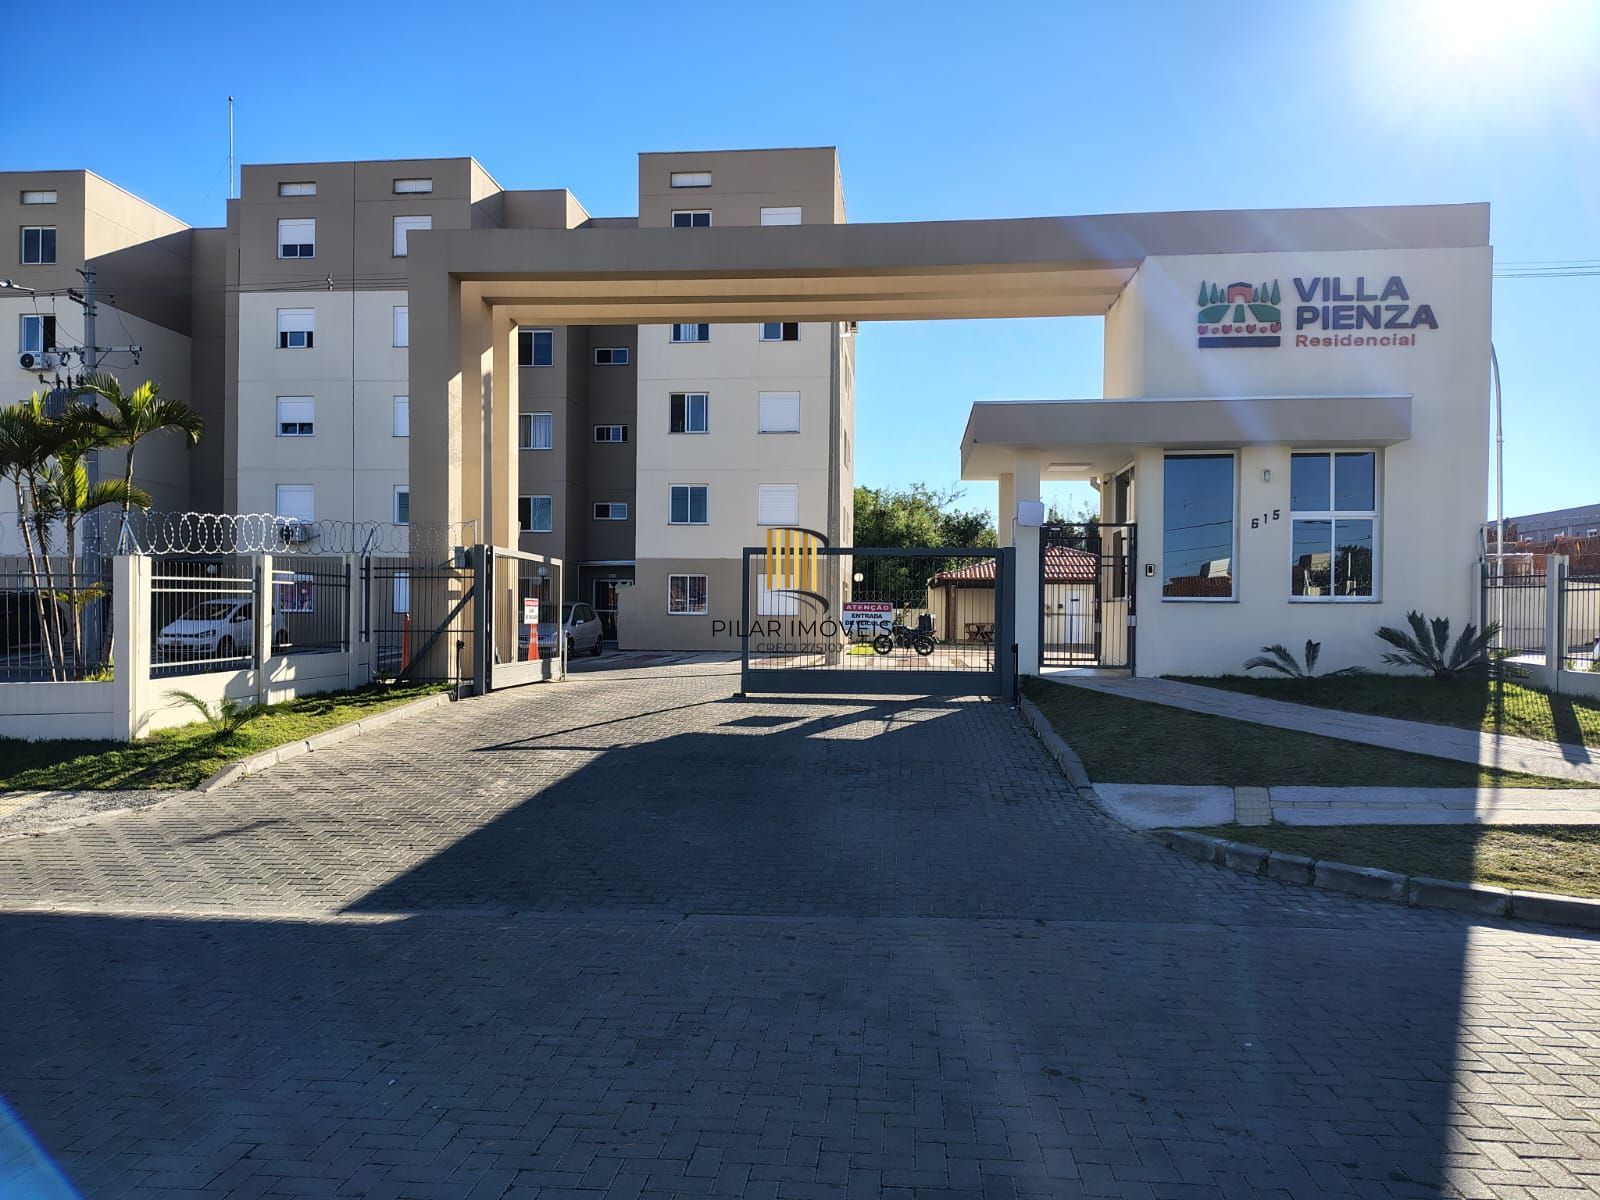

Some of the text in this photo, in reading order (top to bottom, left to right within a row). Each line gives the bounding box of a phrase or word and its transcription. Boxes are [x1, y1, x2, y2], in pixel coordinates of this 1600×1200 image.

[1293, 276, 1410, 302] VILLA
[1296, 304, 1439, 330] PIENZA
[1295, 334, 1416, 347] Residencial
[1251, 509, 1280, 529] 615
